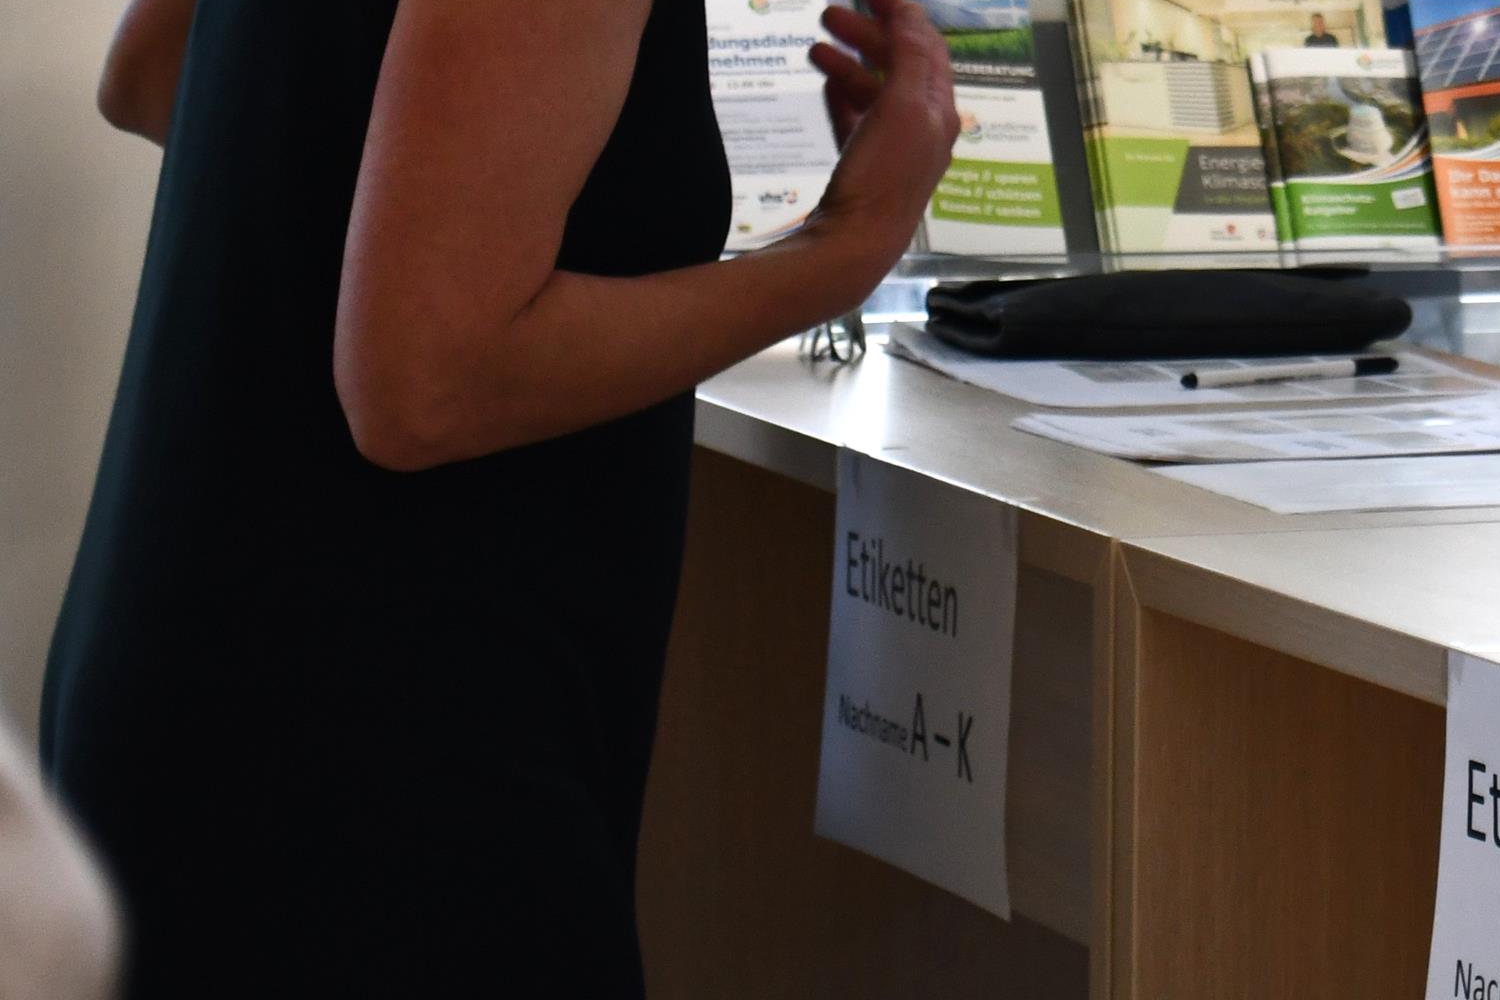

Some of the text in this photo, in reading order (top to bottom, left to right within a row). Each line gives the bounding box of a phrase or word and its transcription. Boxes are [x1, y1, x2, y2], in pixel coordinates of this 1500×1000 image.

[846, 530, 957, 638] Etiketten
[839, 693, 908, 753] Nachname
[910, 692, 928, 762] A
[957, 711, 973, 783] K
